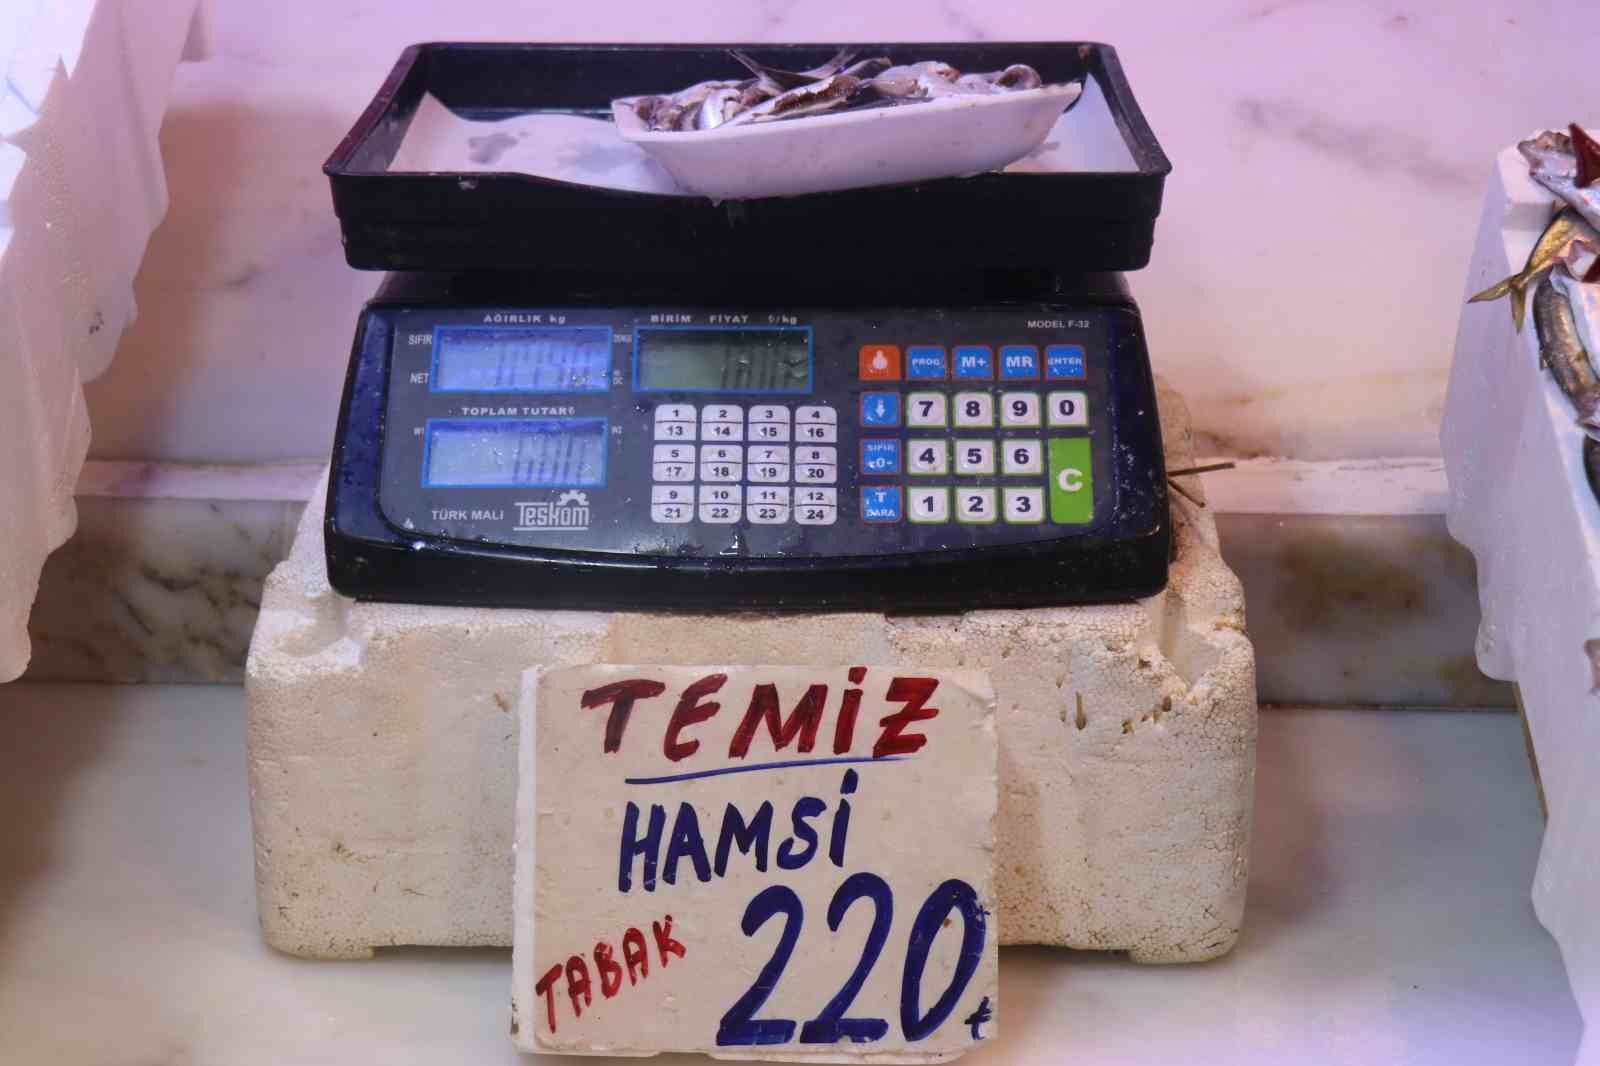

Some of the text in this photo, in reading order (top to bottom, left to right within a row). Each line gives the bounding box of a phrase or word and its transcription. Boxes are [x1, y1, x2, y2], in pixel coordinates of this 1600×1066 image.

[549, 314, 567, 325] kg
[650, 313, 692, 323] BİRİM
[709, 313, 750, 323] FİYAT
[1027, 320, 1065, 329] MODEL
[961, 356, 986, 368] M+
[1006, 356, 1033, 368] MR
[1048, 357, 1082, 367] ENTER
[409, 372, 430, 385] NET
[461, 407, 518, 417] TOPLAM
[918, 400, 934, 417] 7
[965, 400, 981, 417] 8
[1012, 400, 1028, 417] 9
[1059, 399, 1075, 416] 0
[672, 409, 680, 417] 1
[719, 409, 728, 418] 2
[765, 409, 774, 418] 3
[811, 410, 821, 419] 4
[666, 426, 684, 436] 13
[713, 426, 731, 437] 14
[761, 427, 777, 437] 15
[807, 428, 824, 438] 16
[671, 450, 679, 458] 5
[718, 450, 726, 458] 6
[764, 450, 773, 459] 7
[811, 451, 820, 460] 8
[919, 447, 935, 465] 4
[967, 447, 982, 464] 5
[1013, 447, 1029, 465] 6
[666, 467, 683, 476] 17
[712, 467, 729, 476] 18
[761, 467, 777, 477] 19
[807, 468, 825, 478] 20
[1057, 468, 1083, 492] C
[669, 490, 678, 499] 9
[712, 490, 729, 500] 10
[760, 491, 777, 500] 11
[807, 492, 824, 501] 12
[874, 491, 887, 503] T
[922, 496, 935, 512] 1
[968, 496, 984, 512] 2
[1015, 496, 1031, 512] 3
[431, 509, 504, 521] TÜRK MALI
[514, 501, 589, 526] Teskom
[664, 508, 681, 518] 21
[711, 508, 729, 519] 22
[759, 509, 777, 519] 23
[806, 509, 824, 520] 24
[580, 666, 940, 762] TEMİZ
[618, 768, 860, 893] HAMSİ
[535, 914, 687, 1034] TABAK
